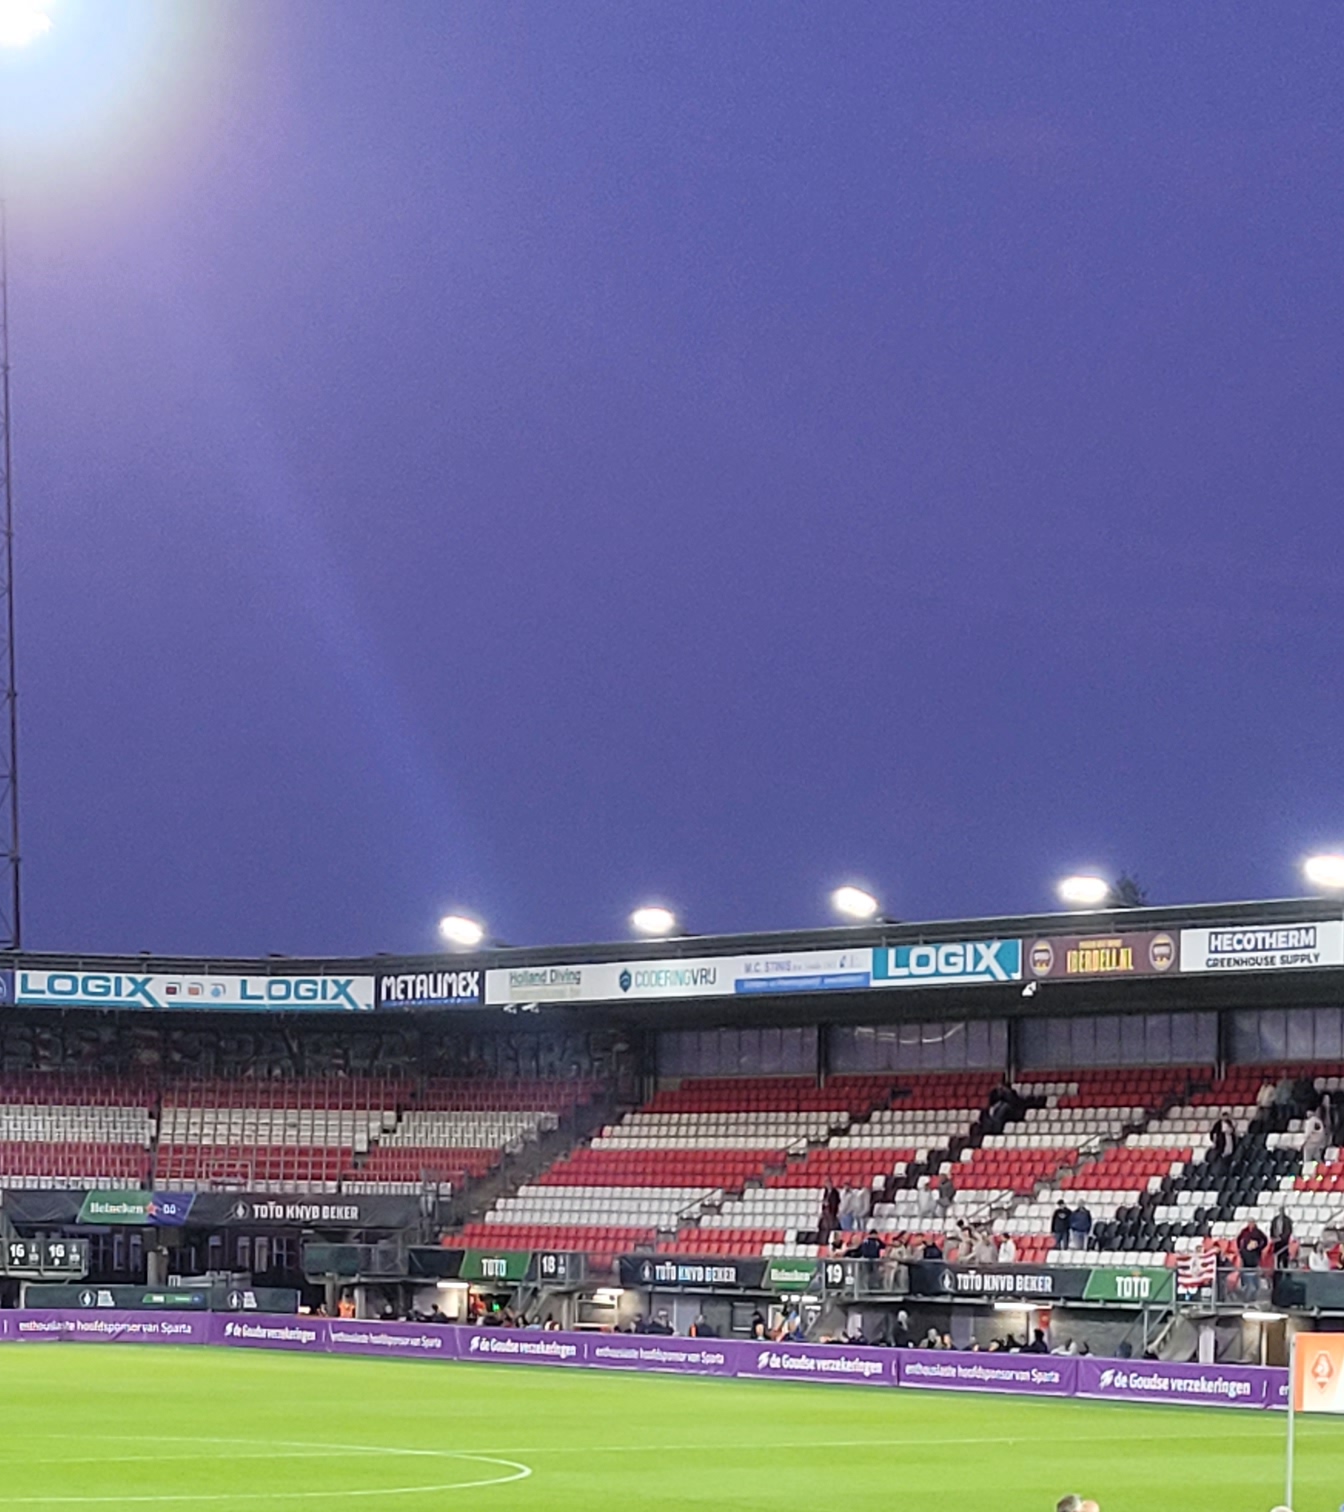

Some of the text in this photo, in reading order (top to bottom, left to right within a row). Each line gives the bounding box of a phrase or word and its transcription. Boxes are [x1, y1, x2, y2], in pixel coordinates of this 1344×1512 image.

[1210, 928, 1315, 951] HECOTHERM
[887, 943, 1006, 979] LOGIX
[1206, 952, 1321, 968] GREENHOUSE SUPPLY
[381, 970, 480, 1000] METALIMEX
[509, 968, 582, 985] Holland Diving
[20, 972, 160, 1003] LOGIX
[240, 978, 360, 1006] LOGIX
[90, 1202, 144, 1214] Heineken
[253, 1202, 359, 1220] TOTO KNVB BEKER
[9, 1244, 25, 1258] 16
[49, 1244, 65, 1258] 16
[481, 1258, 507, 1277] TOTO
[543, 1255, 556, 1274] 18
[655, 1261, 736, 1283] TOTO KNVB BEKER
[826, 1264, 843, 1284] 19
[957, 1270, 1052, 1293] TOTO KNVB BEKER
[1116, 1277, 1150, 1297] TOTO
[479, 1337, 490, 1352] de
[491, 1337, 519, 1354] Goudse
[769, 1353, 883, 1377] de Goudse verzekeringen
[1114, 1371, 1251, 1397] de Goudse verzekeringen
